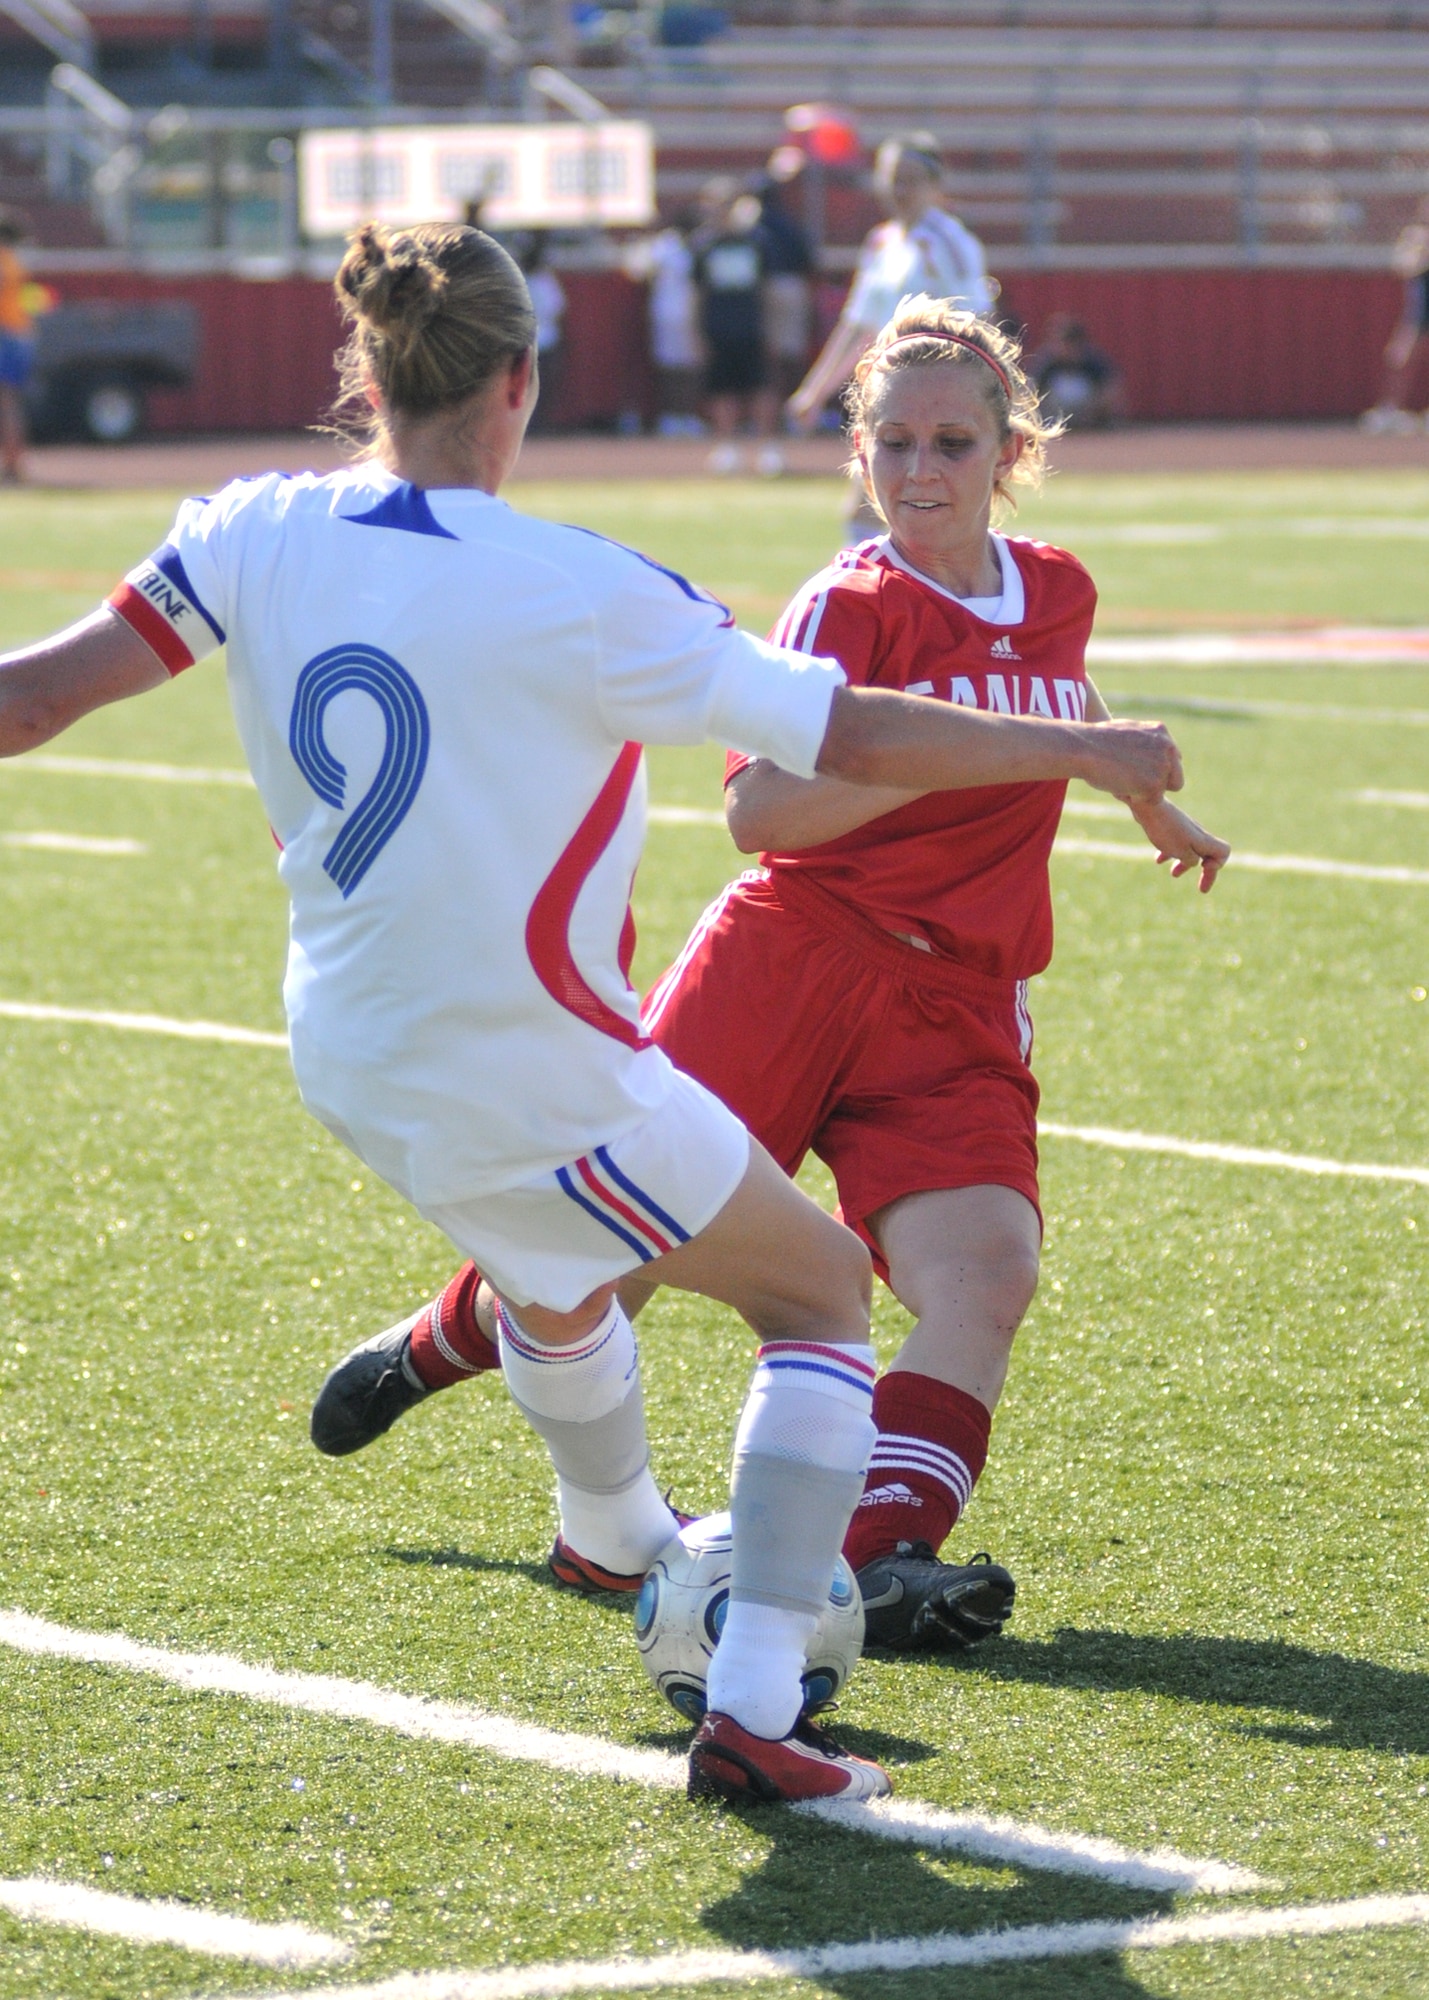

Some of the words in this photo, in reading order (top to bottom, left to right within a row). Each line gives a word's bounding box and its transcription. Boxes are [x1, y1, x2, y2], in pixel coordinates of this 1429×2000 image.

[904, 674, 1087, 722] ANAD
[289, 642, 430, 901] 9
[859, 1490, 924, 1507] didas
